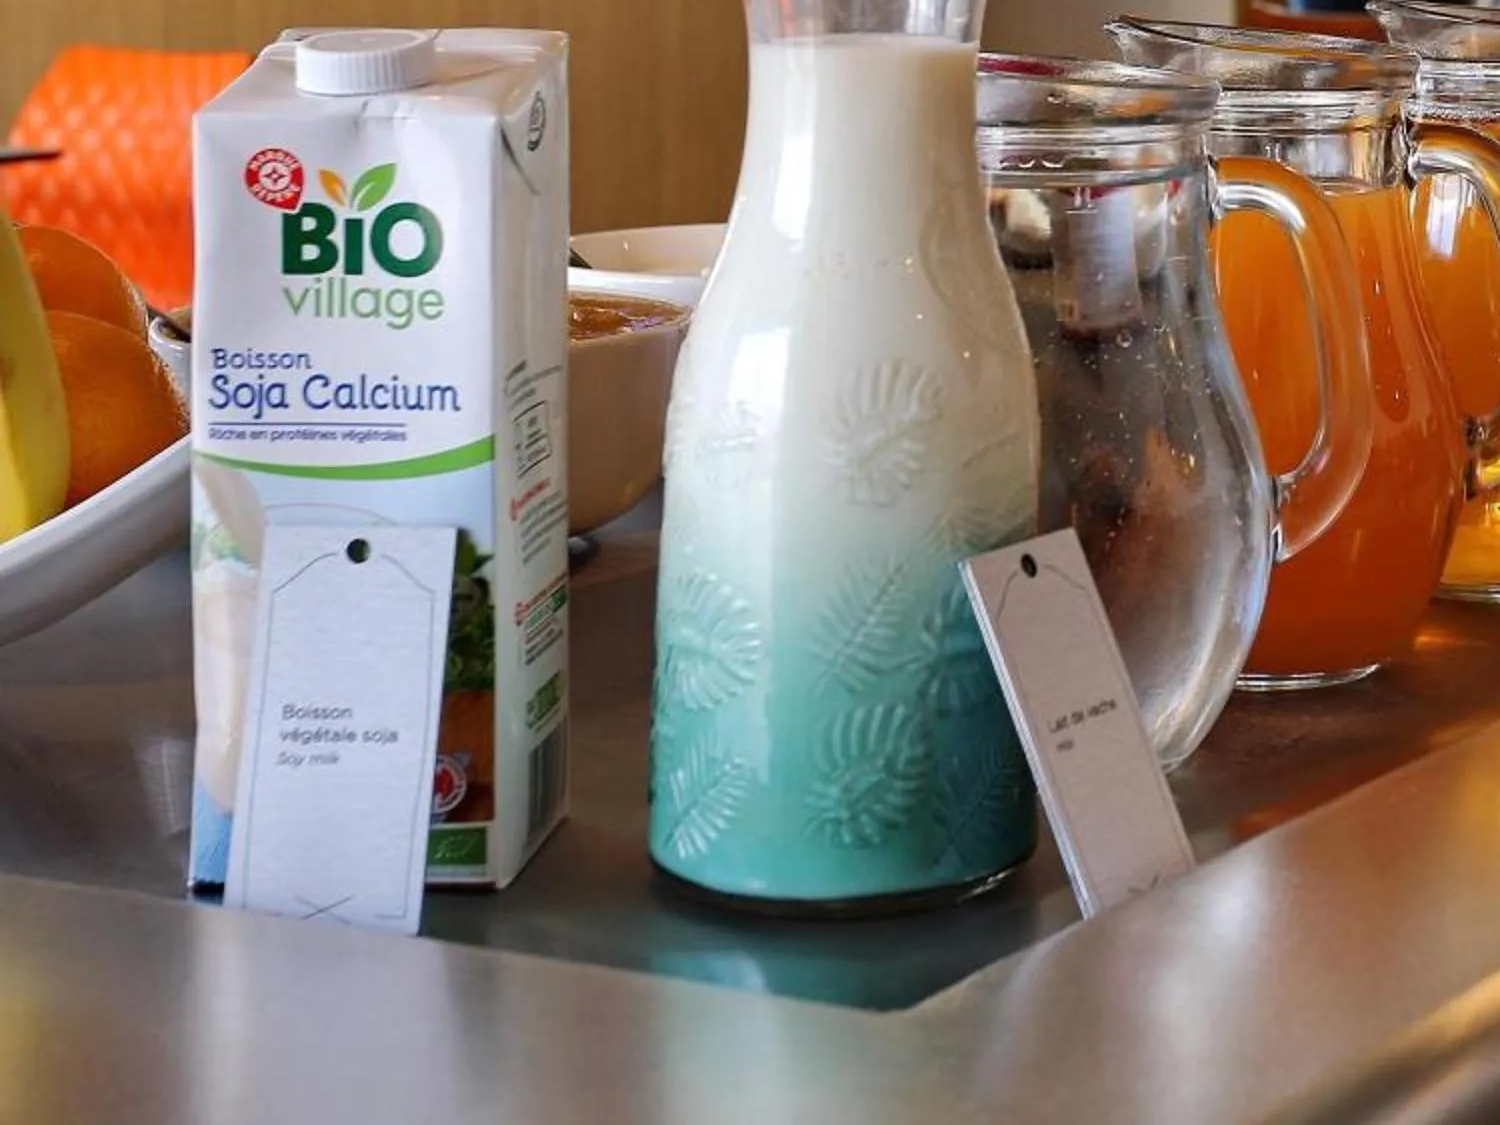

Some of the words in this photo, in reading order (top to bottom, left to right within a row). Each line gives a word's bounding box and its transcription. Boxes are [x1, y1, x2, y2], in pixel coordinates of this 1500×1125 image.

[282, 277, 444, 329] village
[210, 348, 312, 370] Boisson
[208, 373, 289, 420] Soja
[302, 373, 461, 412] Calcium
[282, 704, 353, 720] Boisson
[279, 727, 357, 745] végétale
[362, 729, 398, 745] soja
